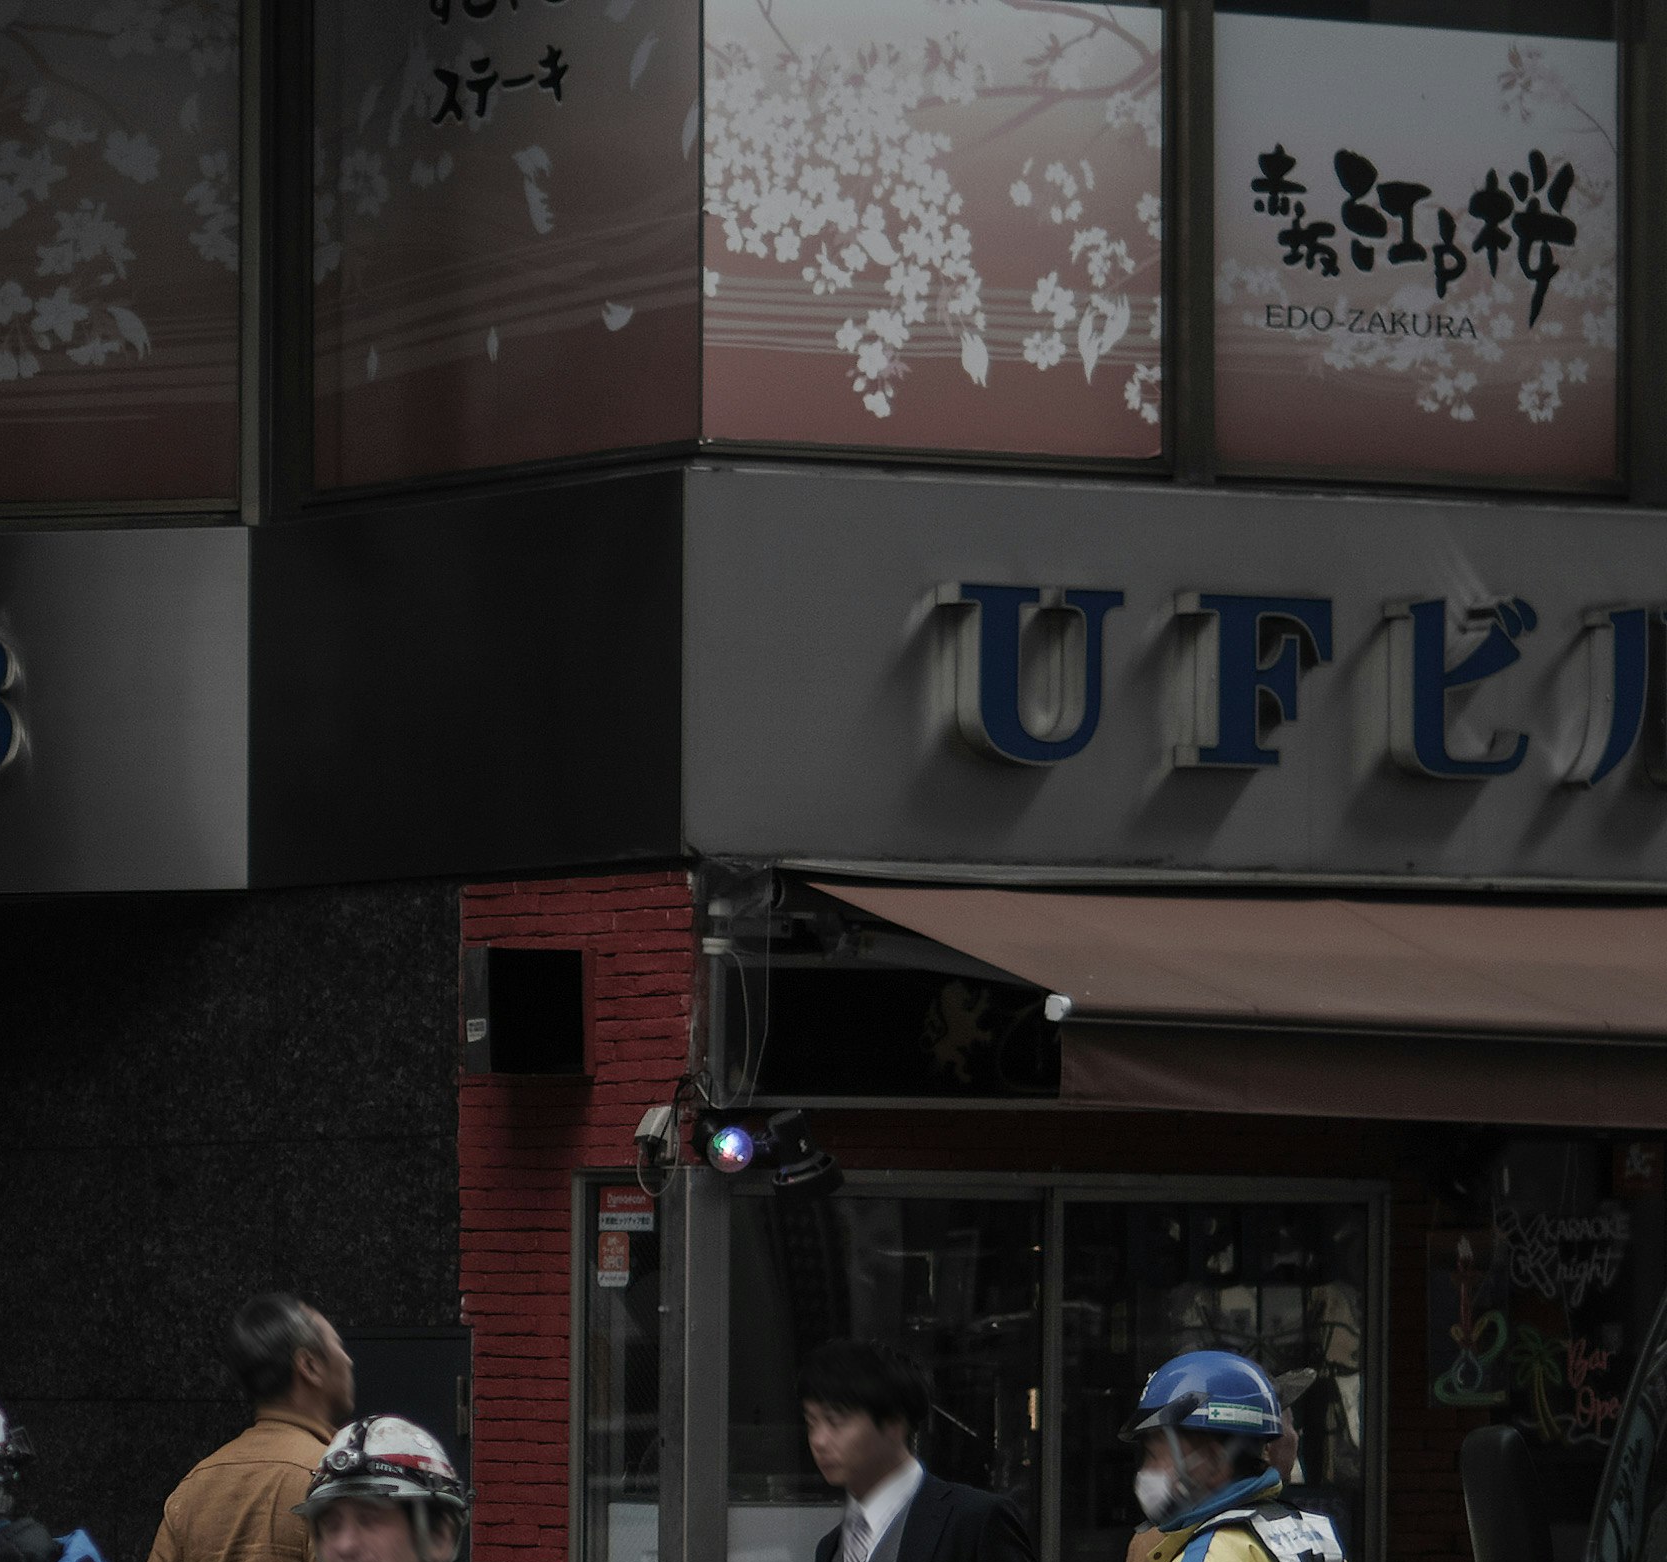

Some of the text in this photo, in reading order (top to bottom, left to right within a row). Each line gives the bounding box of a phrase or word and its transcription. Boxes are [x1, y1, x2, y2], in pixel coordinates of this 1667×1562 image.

[432, 44, 570, 125] ステーキ
[1265, 303, 1480, 340] EDO-ZAKURA
[1574, 1385, 1621, 1440] Ope
